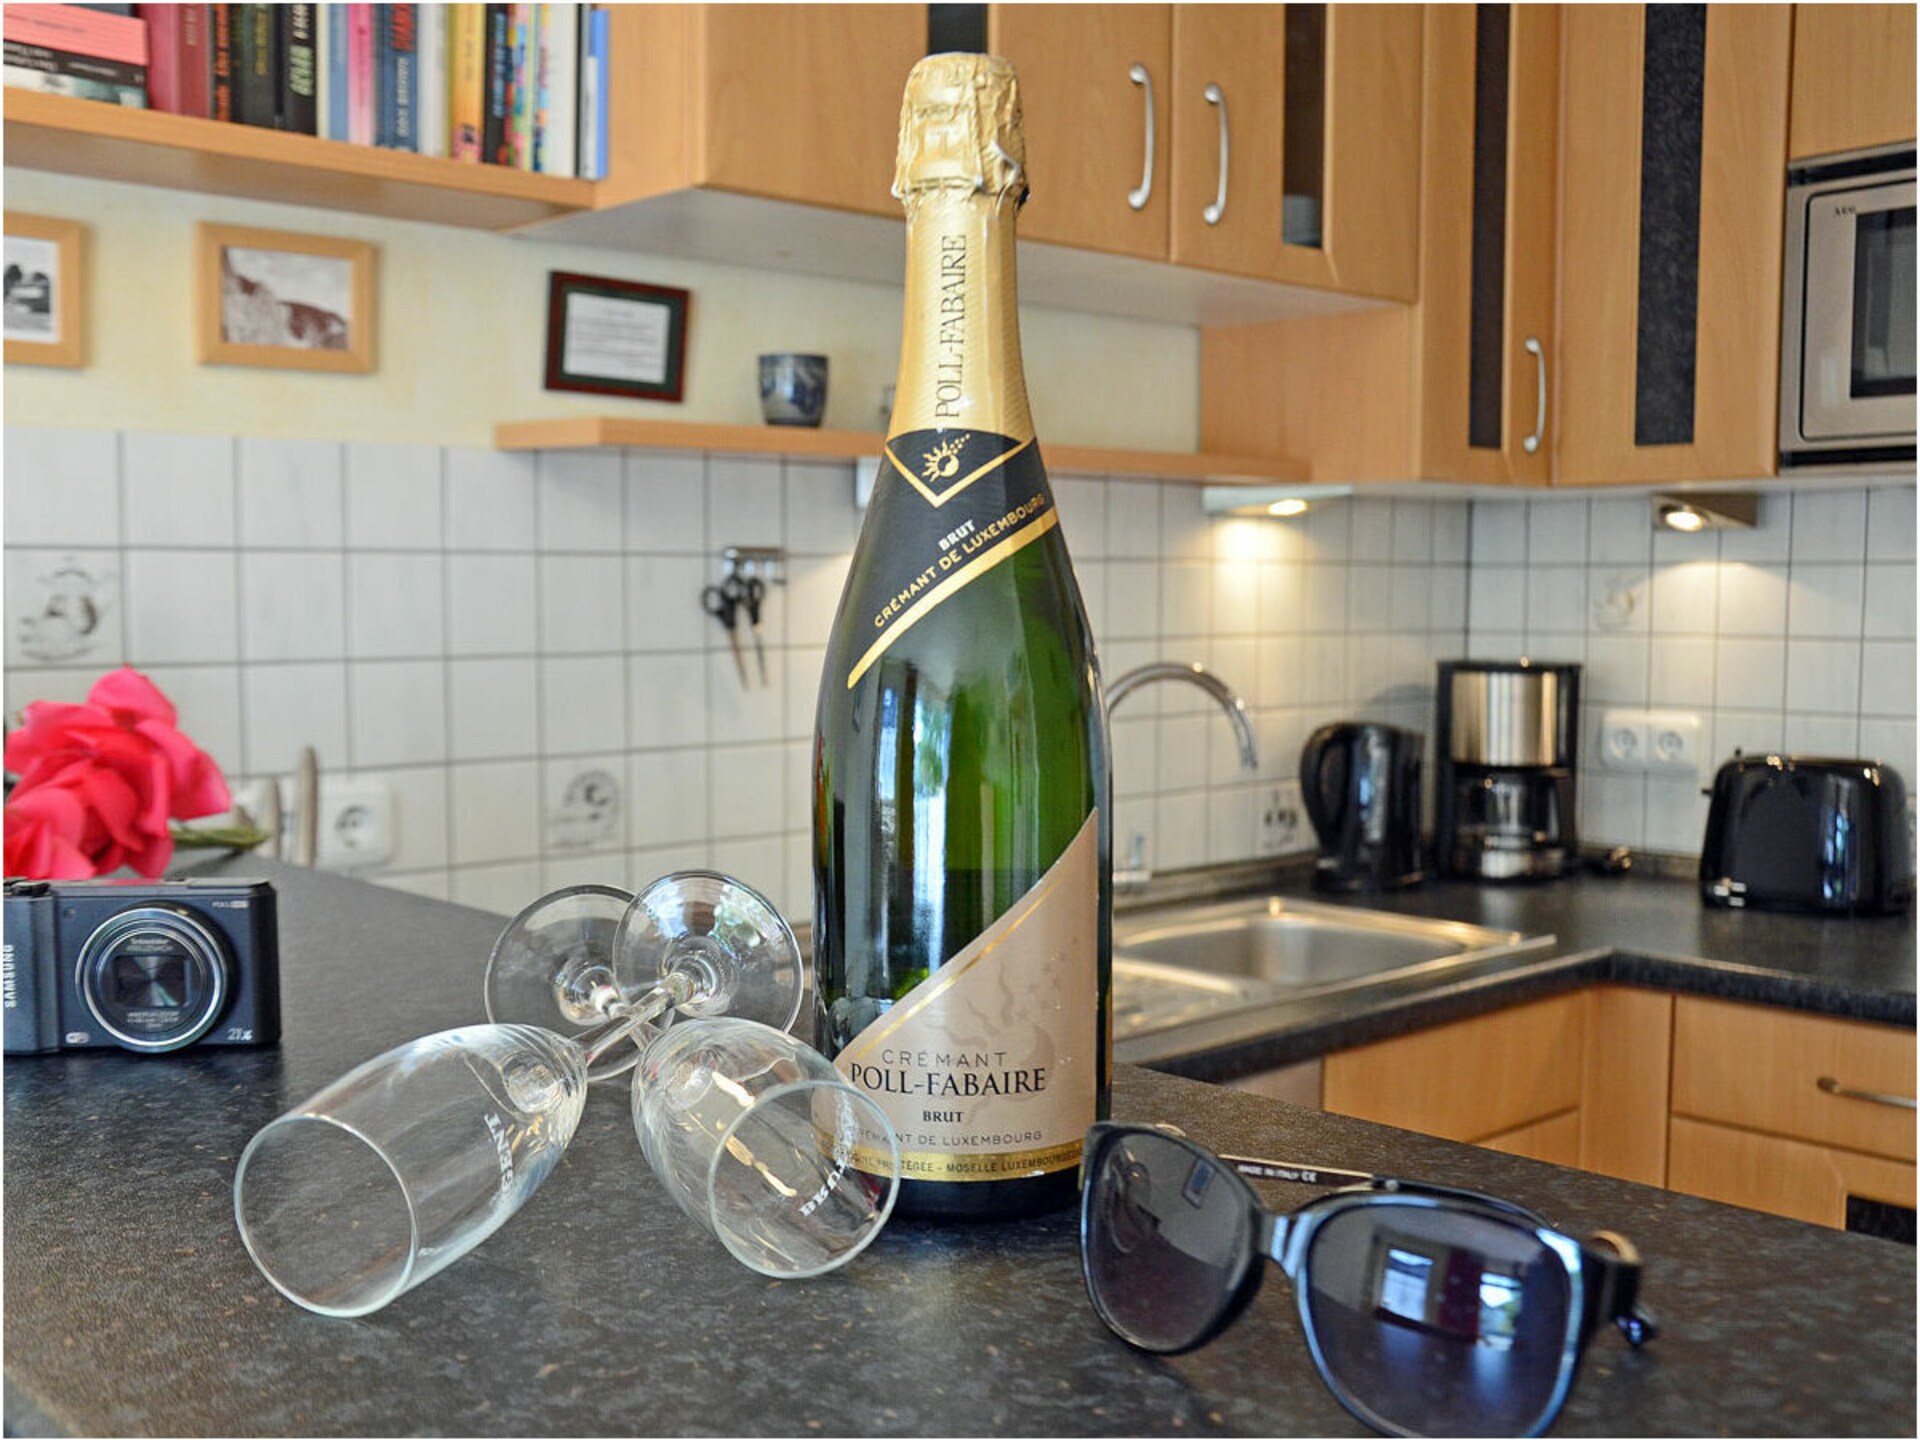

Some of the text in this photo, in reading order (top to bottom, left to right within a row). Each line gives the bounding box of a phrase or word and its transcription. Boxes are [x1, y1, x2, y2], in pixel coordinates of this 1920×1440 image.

[934, 233, 967, 418] POLL-FABAIRE
[938, 519, 976, 551] BRUT
[938, 549, 962, 571] DE
[882, 1049, 1008, 1068] CRÉMANT
[850, 1063, 1047, 1097] POLL-FABAIRE
[922, 1109, 964, 1123] BRUT
[918, 1135, 937, 1146] DE
[943, 1131, 1042, 1148] LUXEMBOURG
[946, 1160, 997, 1173] MOSELLE
